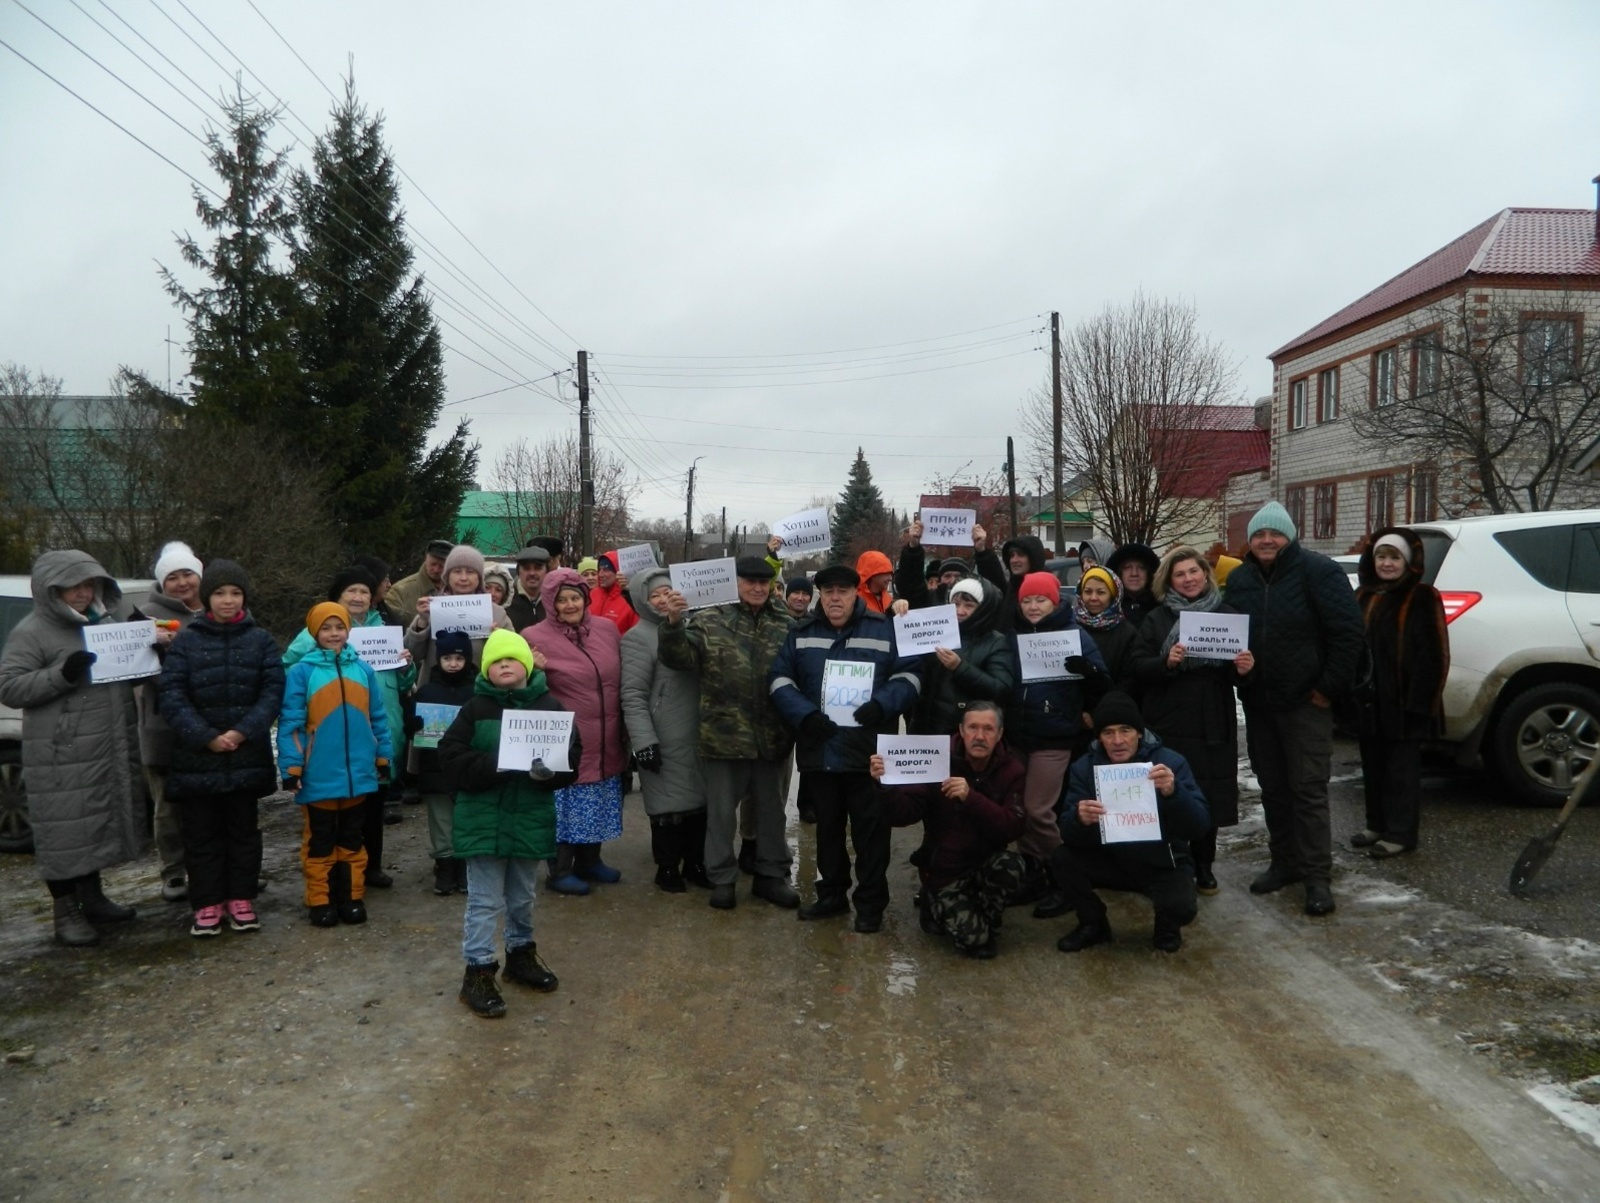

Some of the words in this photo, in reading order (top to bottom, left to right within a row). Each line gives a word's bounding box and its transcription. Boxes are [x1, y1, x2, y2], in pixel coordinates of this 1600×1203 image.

[930, 515, 967, 524] ППМИ
[783, 519, 819, 532] Хотим
[957, 527, 966, 535] 25
[681, 567, 726, 579] Тубанкуль
[695, 577, 730, 587] Полевая
[698, 588, 715, 597] 1-17
[441, 600, 482, 608] ПОЛЕВАЯ
[922, 619, 949, 627] НУЖНА
[91, 630, 127, 643] ППМИ
[129, 628, 151, 639] 2025
[911, 630, 944, 640] ДОРОГА!
[109, 641, 152, 653] ПОЛЕВАЯ
[117, 654, 135, 665] 1-17
[1044, 660, 1060, 669] 1-17
[829, 663, 872, 679] ППМИ
[509, 719, 547, 730] ППМИ
[549, 720, 569, 731] 2025
[508, 736, 522, 744] ул.
[525, 734, 566, 744] ПОЛЕВАЯ
[532, 748, 550, 758] 1-17
[895, 759, 932, 767] ДОРОГА!
[1111, 785, 1142, 800] 1-17
[1113, 811, 1158, 827] ТУЙМАЗЫ
